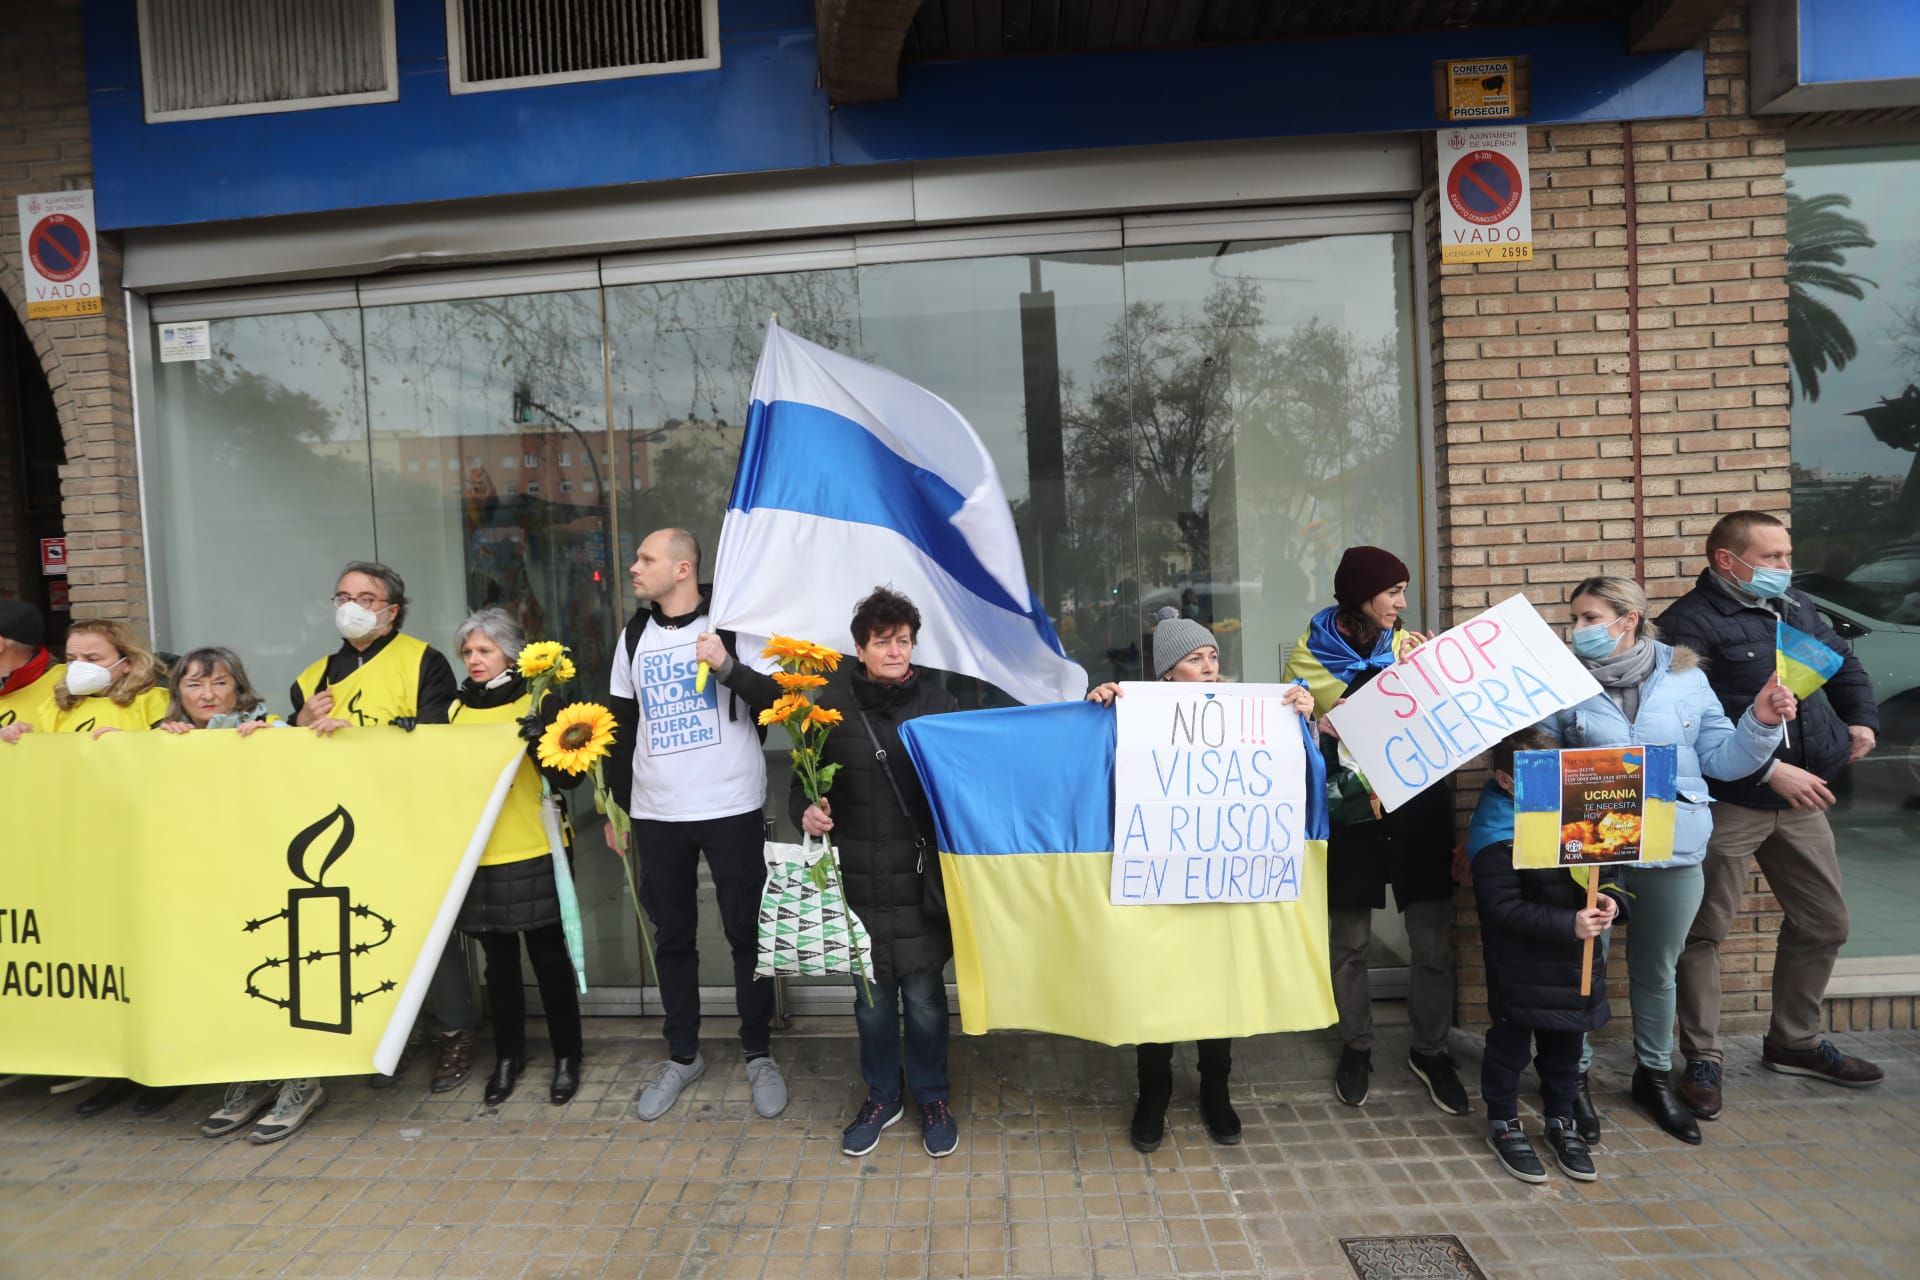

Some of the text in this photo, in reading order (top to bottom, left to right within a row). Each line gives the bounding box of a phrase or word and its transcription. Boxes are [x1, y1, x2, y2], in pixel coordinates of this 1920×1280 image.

[1452, 64, 1508, 73] CONECTADA
[1454, 107, 1510, 116] PROSEGUR
[1469, 132, 1517, 140] AJUNTAMENT
[1469, 141, 1480, 149] DE
[1454, 226, 1520, 244] VADO
[1485, 247, 1493, 258] Y
[1502, 246, 1528, 257] 2696
[36, 282, 91, 299] VADO
[63, 303, 69, 313] Y
[76, 300, 97, 311] 2696
[643, 652, 673, 669] SOY
[1376, 618, 1502, 719] STOP
[646, 682, 684, 706] NO
[648, 697, 708, 720] GUERRA
[650, 714, 702, 736] FUERA
[1171, 698, 1266, 748] NO !!!
[1385, 665, 1566, 788] GUERRA
[651, 727, 714, 750] PUTLER!
[1152, 749, 1273, 798] VISAS
[1584, 788, 1637, 800] UCRANIA
[1584, 801, 1637, 811] TE NECESITA
[1122, 802, 1293, 854] A RUSOS
[1122, 854, 1299, 900] EN EUROPA
